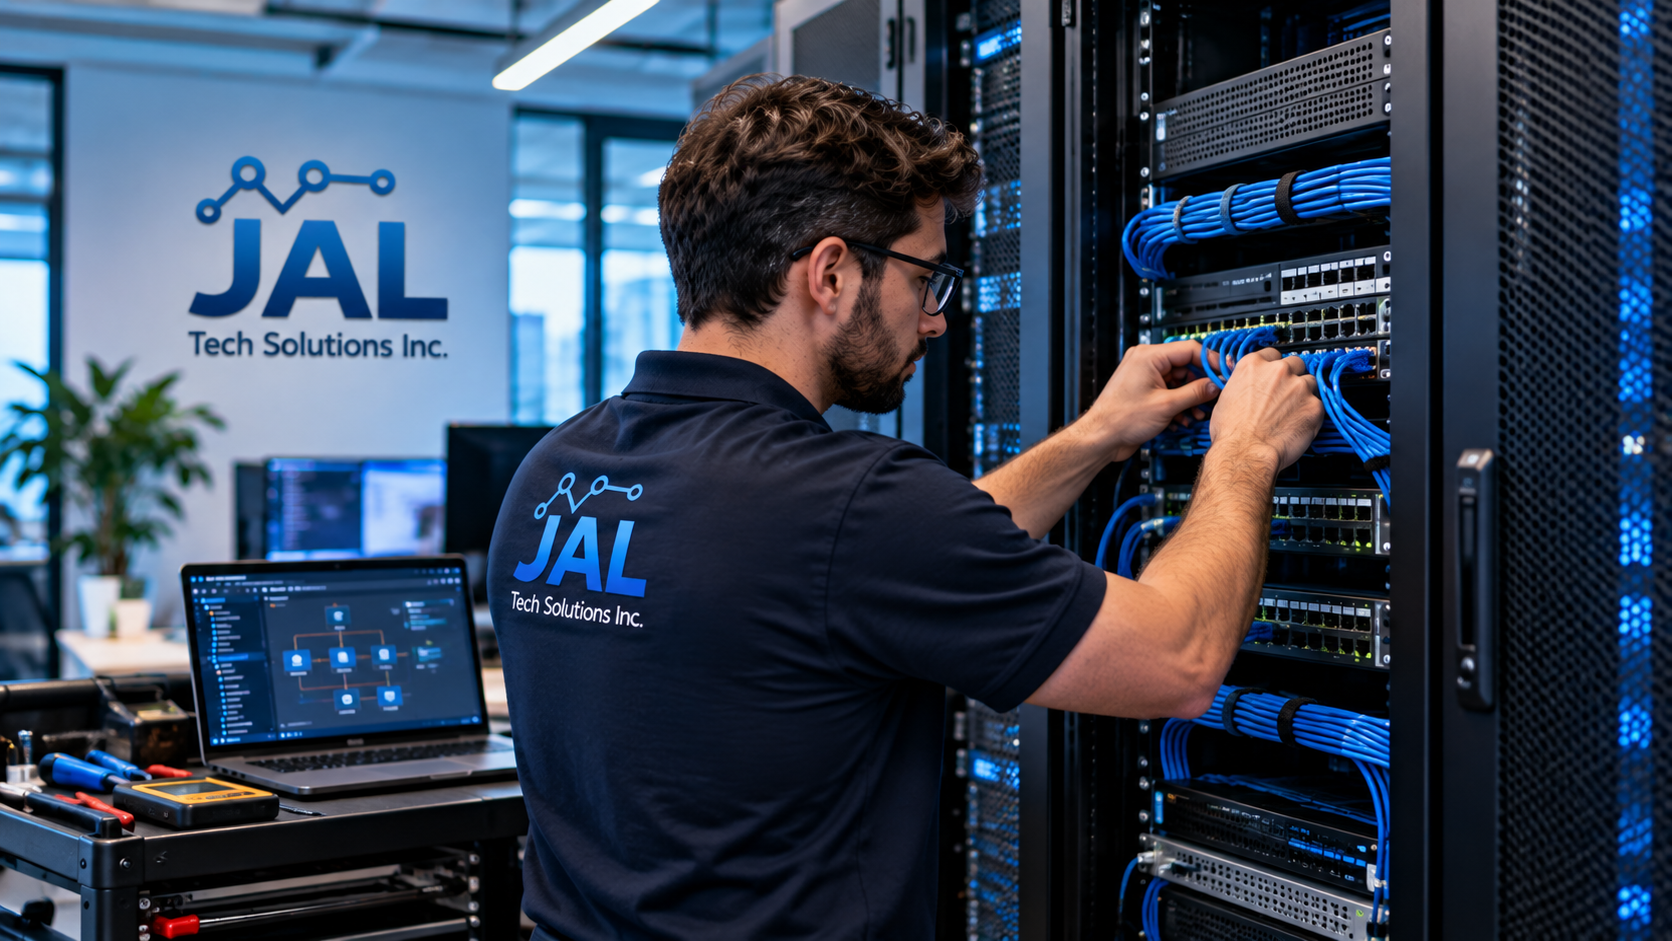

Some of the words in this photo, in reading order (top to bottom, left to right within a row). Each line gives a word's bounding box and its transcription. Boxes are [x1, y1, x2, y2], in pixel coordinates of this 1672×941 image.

[188, 218, 448, 320] JAL
[188, 331, 253, 356] Tech
[263, 331, 393, 357] Solutions
[402, 333, 449, 358] Inc.
[513, 514, 647, 598] JAL
[511, 591, 540, 614] Tech
[543, 595, 611, 624] Solutions
[615, 605, 644, 628] Inc.
